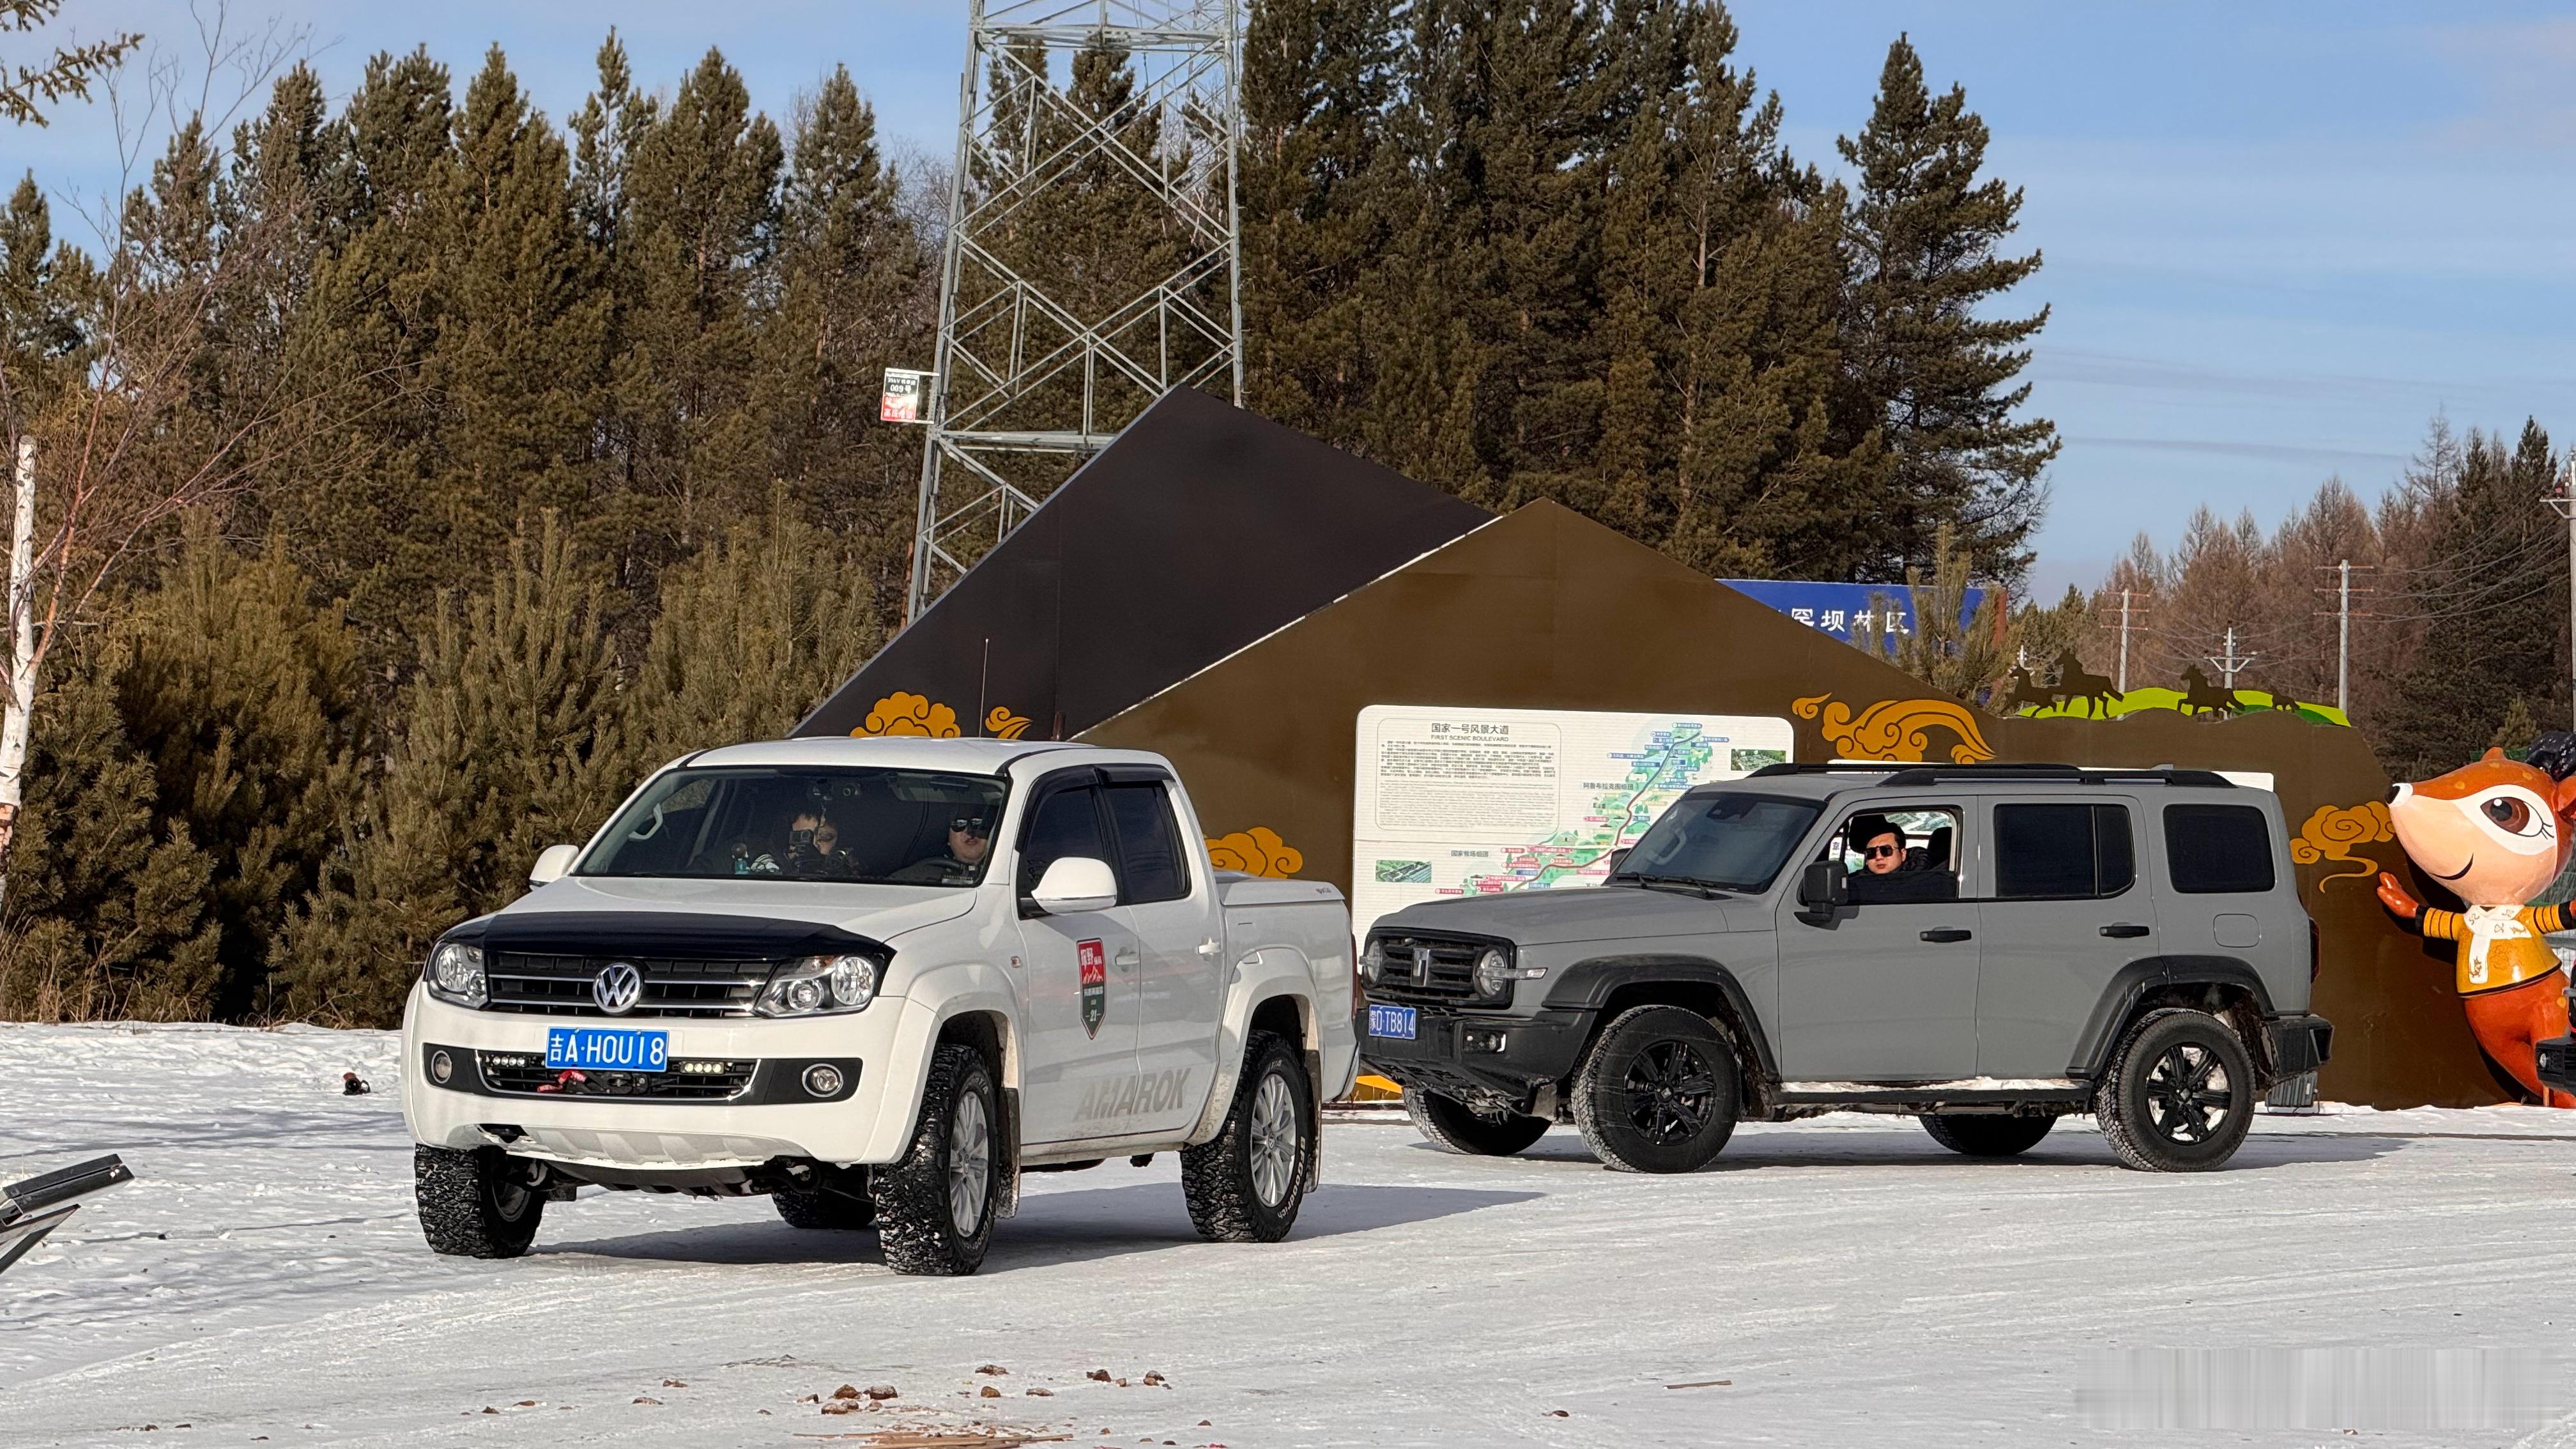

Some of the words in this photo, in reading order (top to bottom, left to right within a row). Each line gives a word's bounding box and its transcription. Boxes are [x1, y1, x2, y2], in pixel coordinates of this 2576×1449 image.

[1777, 608, 1910, 634] 罕坝林区
[1430, 723, 1509, 735] 国家一号风景大道
[1089, 1009, 1098, 1022] 21
[1073, 1067, 1192, 1122] AMAROK
